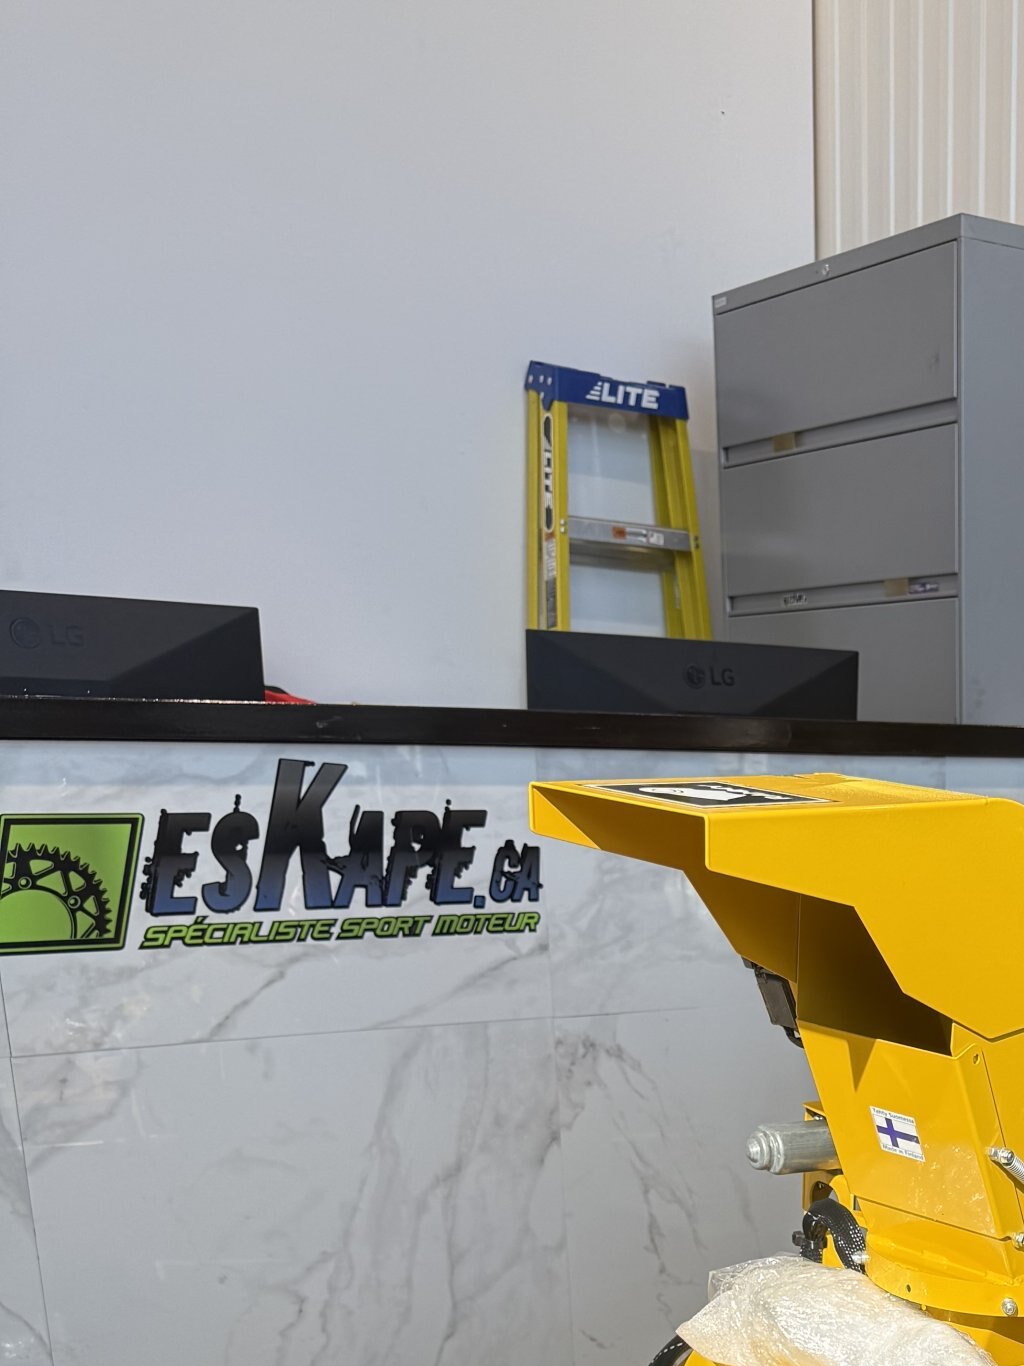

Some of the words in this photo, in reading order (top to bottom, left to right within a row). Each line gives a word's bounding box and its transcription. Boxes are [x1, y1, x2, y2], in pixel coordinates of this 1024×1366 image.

[600, 381, 660, 410] LITE
[51, 625, 84, 648] LG
[711, 667, 735, 687] LG
[138, 916, 338, 949] SPÉCIALISTE
[336, 915, 433, 940] SPORT
[431, 912, 541, 937] MOTEUR
